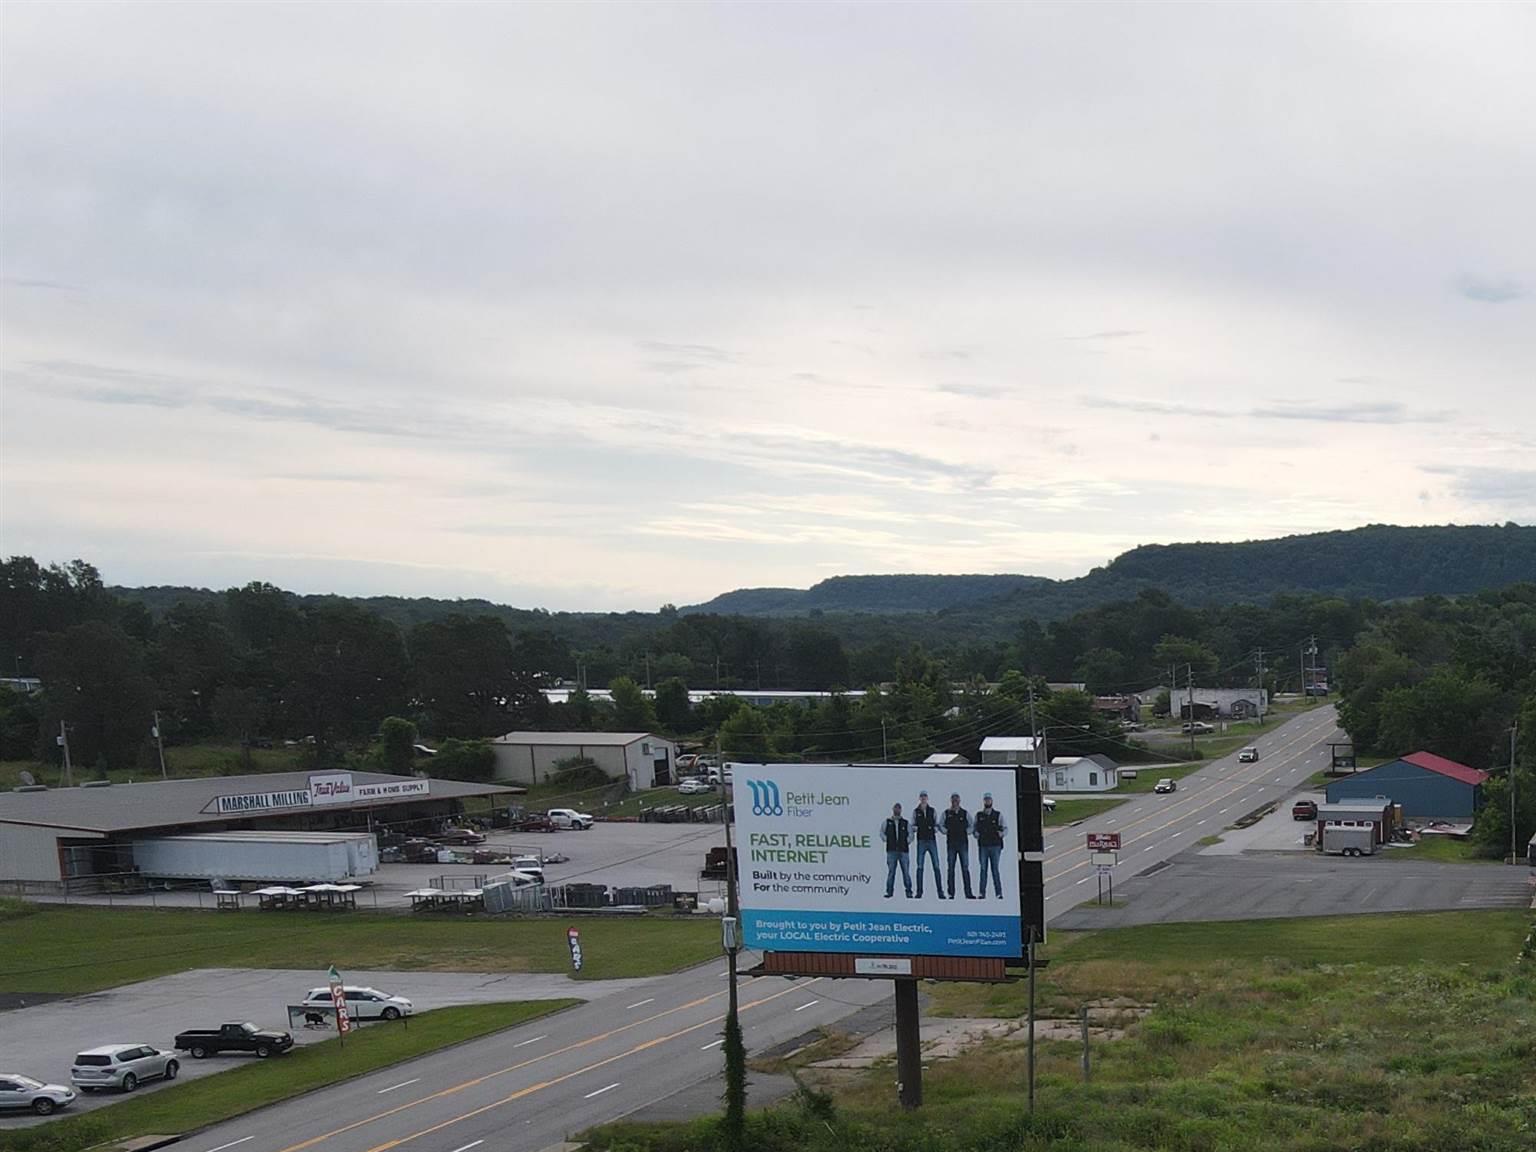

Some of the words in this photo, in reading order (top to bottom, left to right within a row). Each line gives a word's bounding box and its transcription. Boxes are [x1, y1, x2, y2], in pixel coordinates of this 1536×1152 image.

[402, 783, 424, 793] SUPPLY
[222, 794, 271, 811] MARSHALL
[272, 791, 309, 807] MILLING
[786, 792, 815, 805] Petit
[817, 792, 850, 806] Jean
[787, 807, 813, 818] Fiber
[750, 833, 792, 849] FAST,
[795, 834, 871, 848] RELIABLE
[751, 849, 828, 864] INTERNET
[753, 870, 778, 880] Built
[779, 871, 792, 882] by
[793, 872, 811, 881] the
[812, 873, 871, 884] community
[753, 883, 770, 892] For
[772, 883, 789, 892] the
[791, 884, 850, 896] community
[756, 920, 795, 931] Brought
[797, 921, 808, 929] to
[809, 922, 828, 932] you
[829, 922, 841, 932] by
[843, 921, 867, 931] Petit
[868, 922, 892, 932] Jean
[894, 923, 933, 933] Electric,
[756, 932, 778, 941] your
[780, 932, 813, 940] LOCAL
[814, 932, 850, 942] Electric
[852, 933, 910, 944] Cooperative
[333, 986, 349, 1031] CARS
